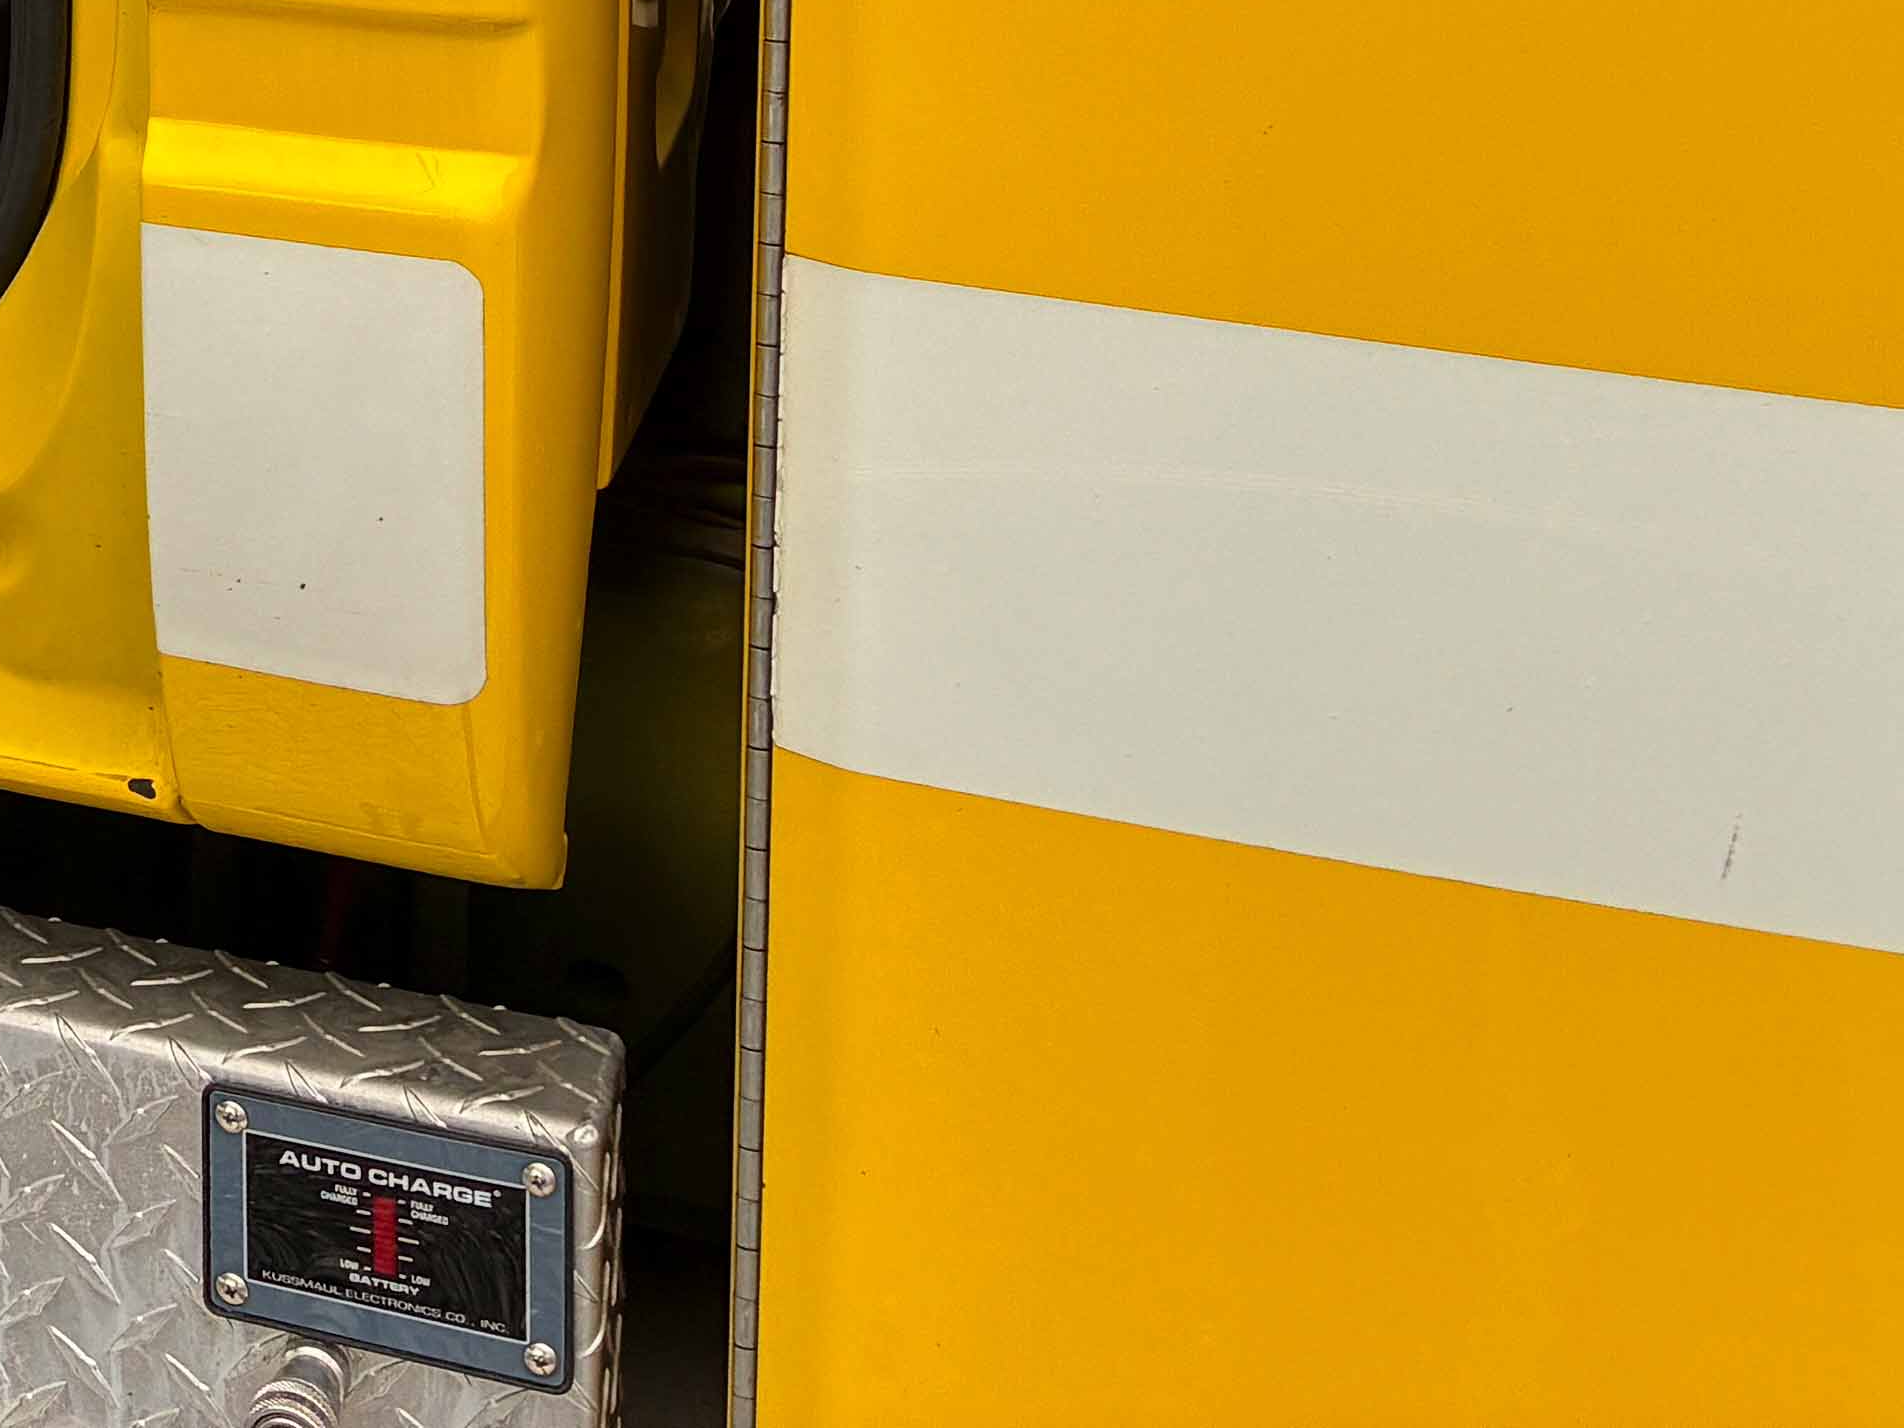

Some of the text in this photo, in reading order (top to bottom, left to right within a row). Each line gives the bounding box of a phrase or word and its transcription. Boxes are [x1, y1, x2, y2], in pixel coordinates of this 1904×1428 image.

[279, 1150, 361, 1180] AUTO
[334, 1184, 358, 1195] FULLY
[320, 1190, 358, 1206] CHARGED
[410, 1200, 434, 1212] FULLY
[410, 1210, 449, 1226] CHARGED
[339, 1258, 359, 1270] LOW
[349, 1272, 420, 1297] BATTERY
[411, 1275, 431, 1287] LOW
[261, 1270, 340, 1296] KUSSMAUL
[345, 1289, 441, 1318] ELECTRONICS
